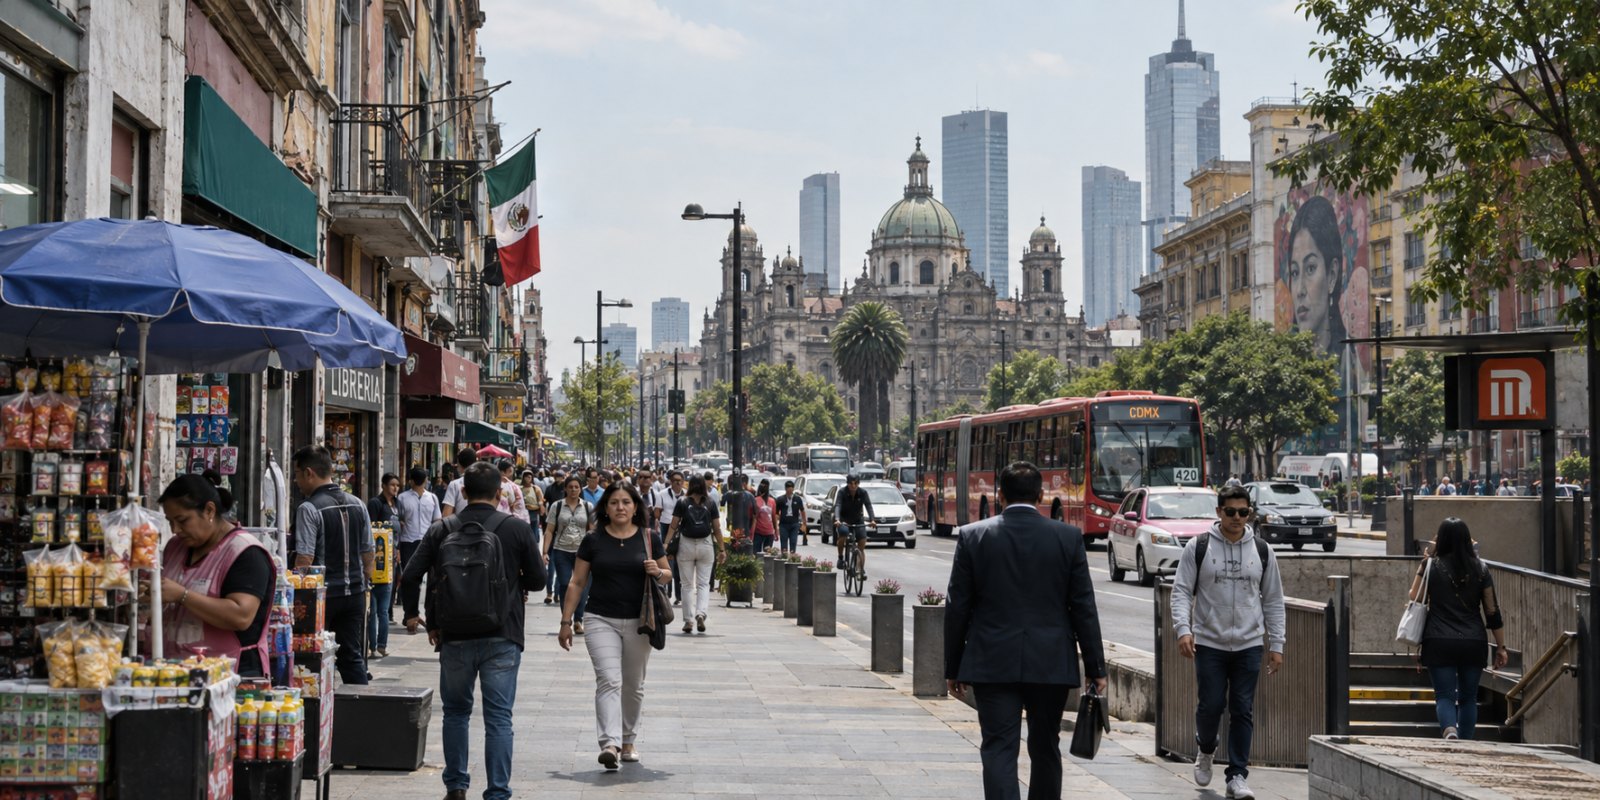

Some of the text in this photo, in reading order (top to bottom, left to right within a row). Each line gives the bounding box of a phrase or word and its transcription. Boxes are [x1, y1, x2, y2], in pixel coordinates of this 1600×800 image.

[331, 368, 381, 404] LIBRERIA
[1129, 407, 1160, 418] CDMX
[1175, 469, 1197, 481] 420
